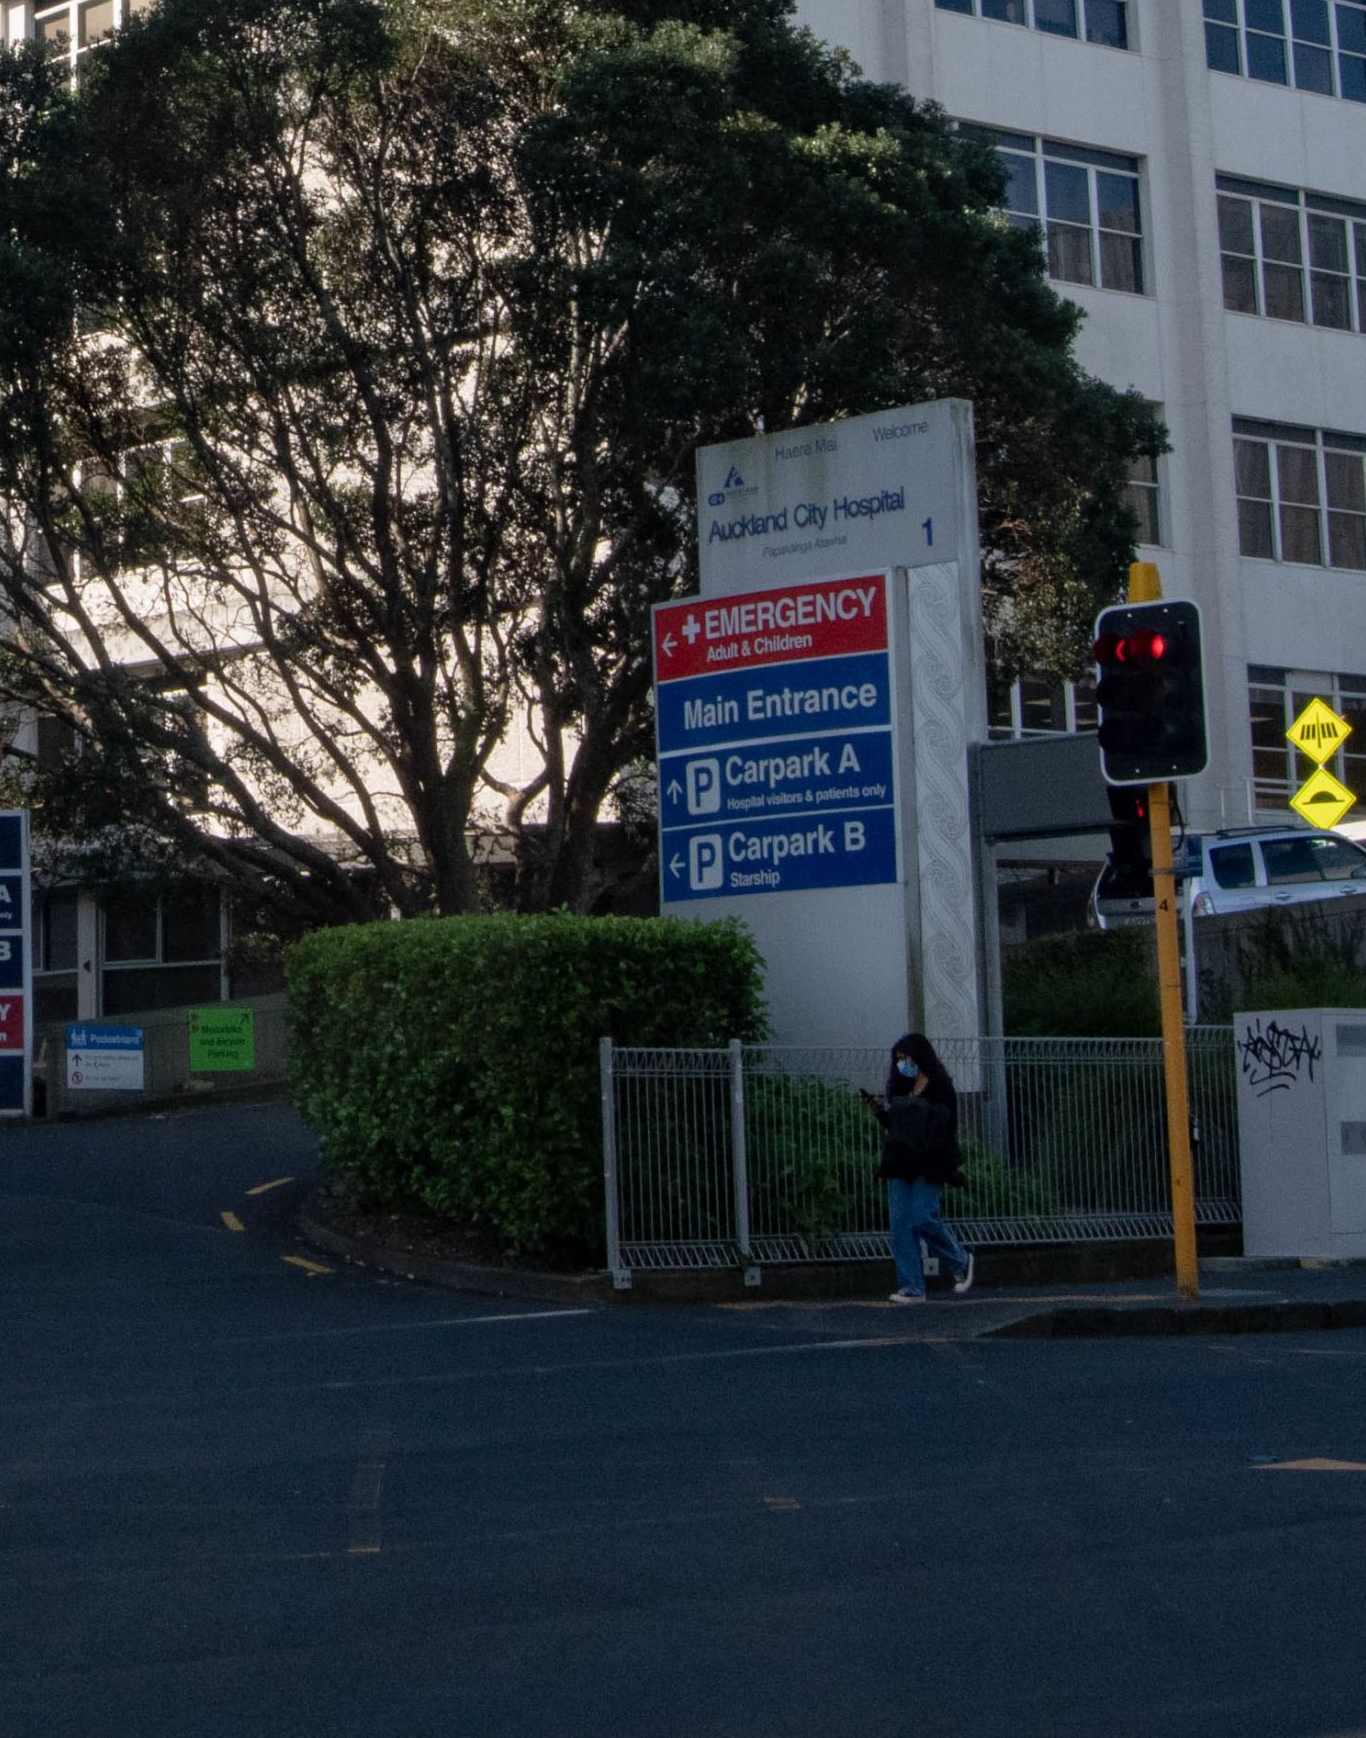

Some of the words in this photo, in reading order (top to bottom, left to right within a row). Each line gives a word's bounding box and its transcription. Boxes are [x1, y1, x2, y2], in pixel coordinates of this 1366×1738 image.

[873, 420, 929, 442] Welcome
[774, 443, 812, 460] Haere
[709, 507, 787, 543] Auckland
[794, 503, 828, 530] City
[834, 486, 905, 520] Hospital
[921, 518, 933, 546] 1
[704, 586, 877, 640] EMERGENCY
[706, 643, 739, 662] Adult
[741, 640, 751, 656] &
[754, 634, 813, 655] Children
[683, 696, 740, 730] Main
[747, 682, 878, 720] Entrance
[725, 746, 831, 789] Carpark
[838, 743, 862, 774] A
[694, 766, 713, 808] P
[727, 794, 765, 811] Hospital
[766, 790, 803, 806] visitors
[805, 789, 814, 801] &
[816, 786, 860, 804] patients
[862, 783, 887, 799] only
[728, 823, 835, 866] Carpark
[844, 820, 866, 852] B
[697, 841, 716, 883] P
[730, 869, 780, 888] Starship
[1158, 898, 1169, 912] 4
